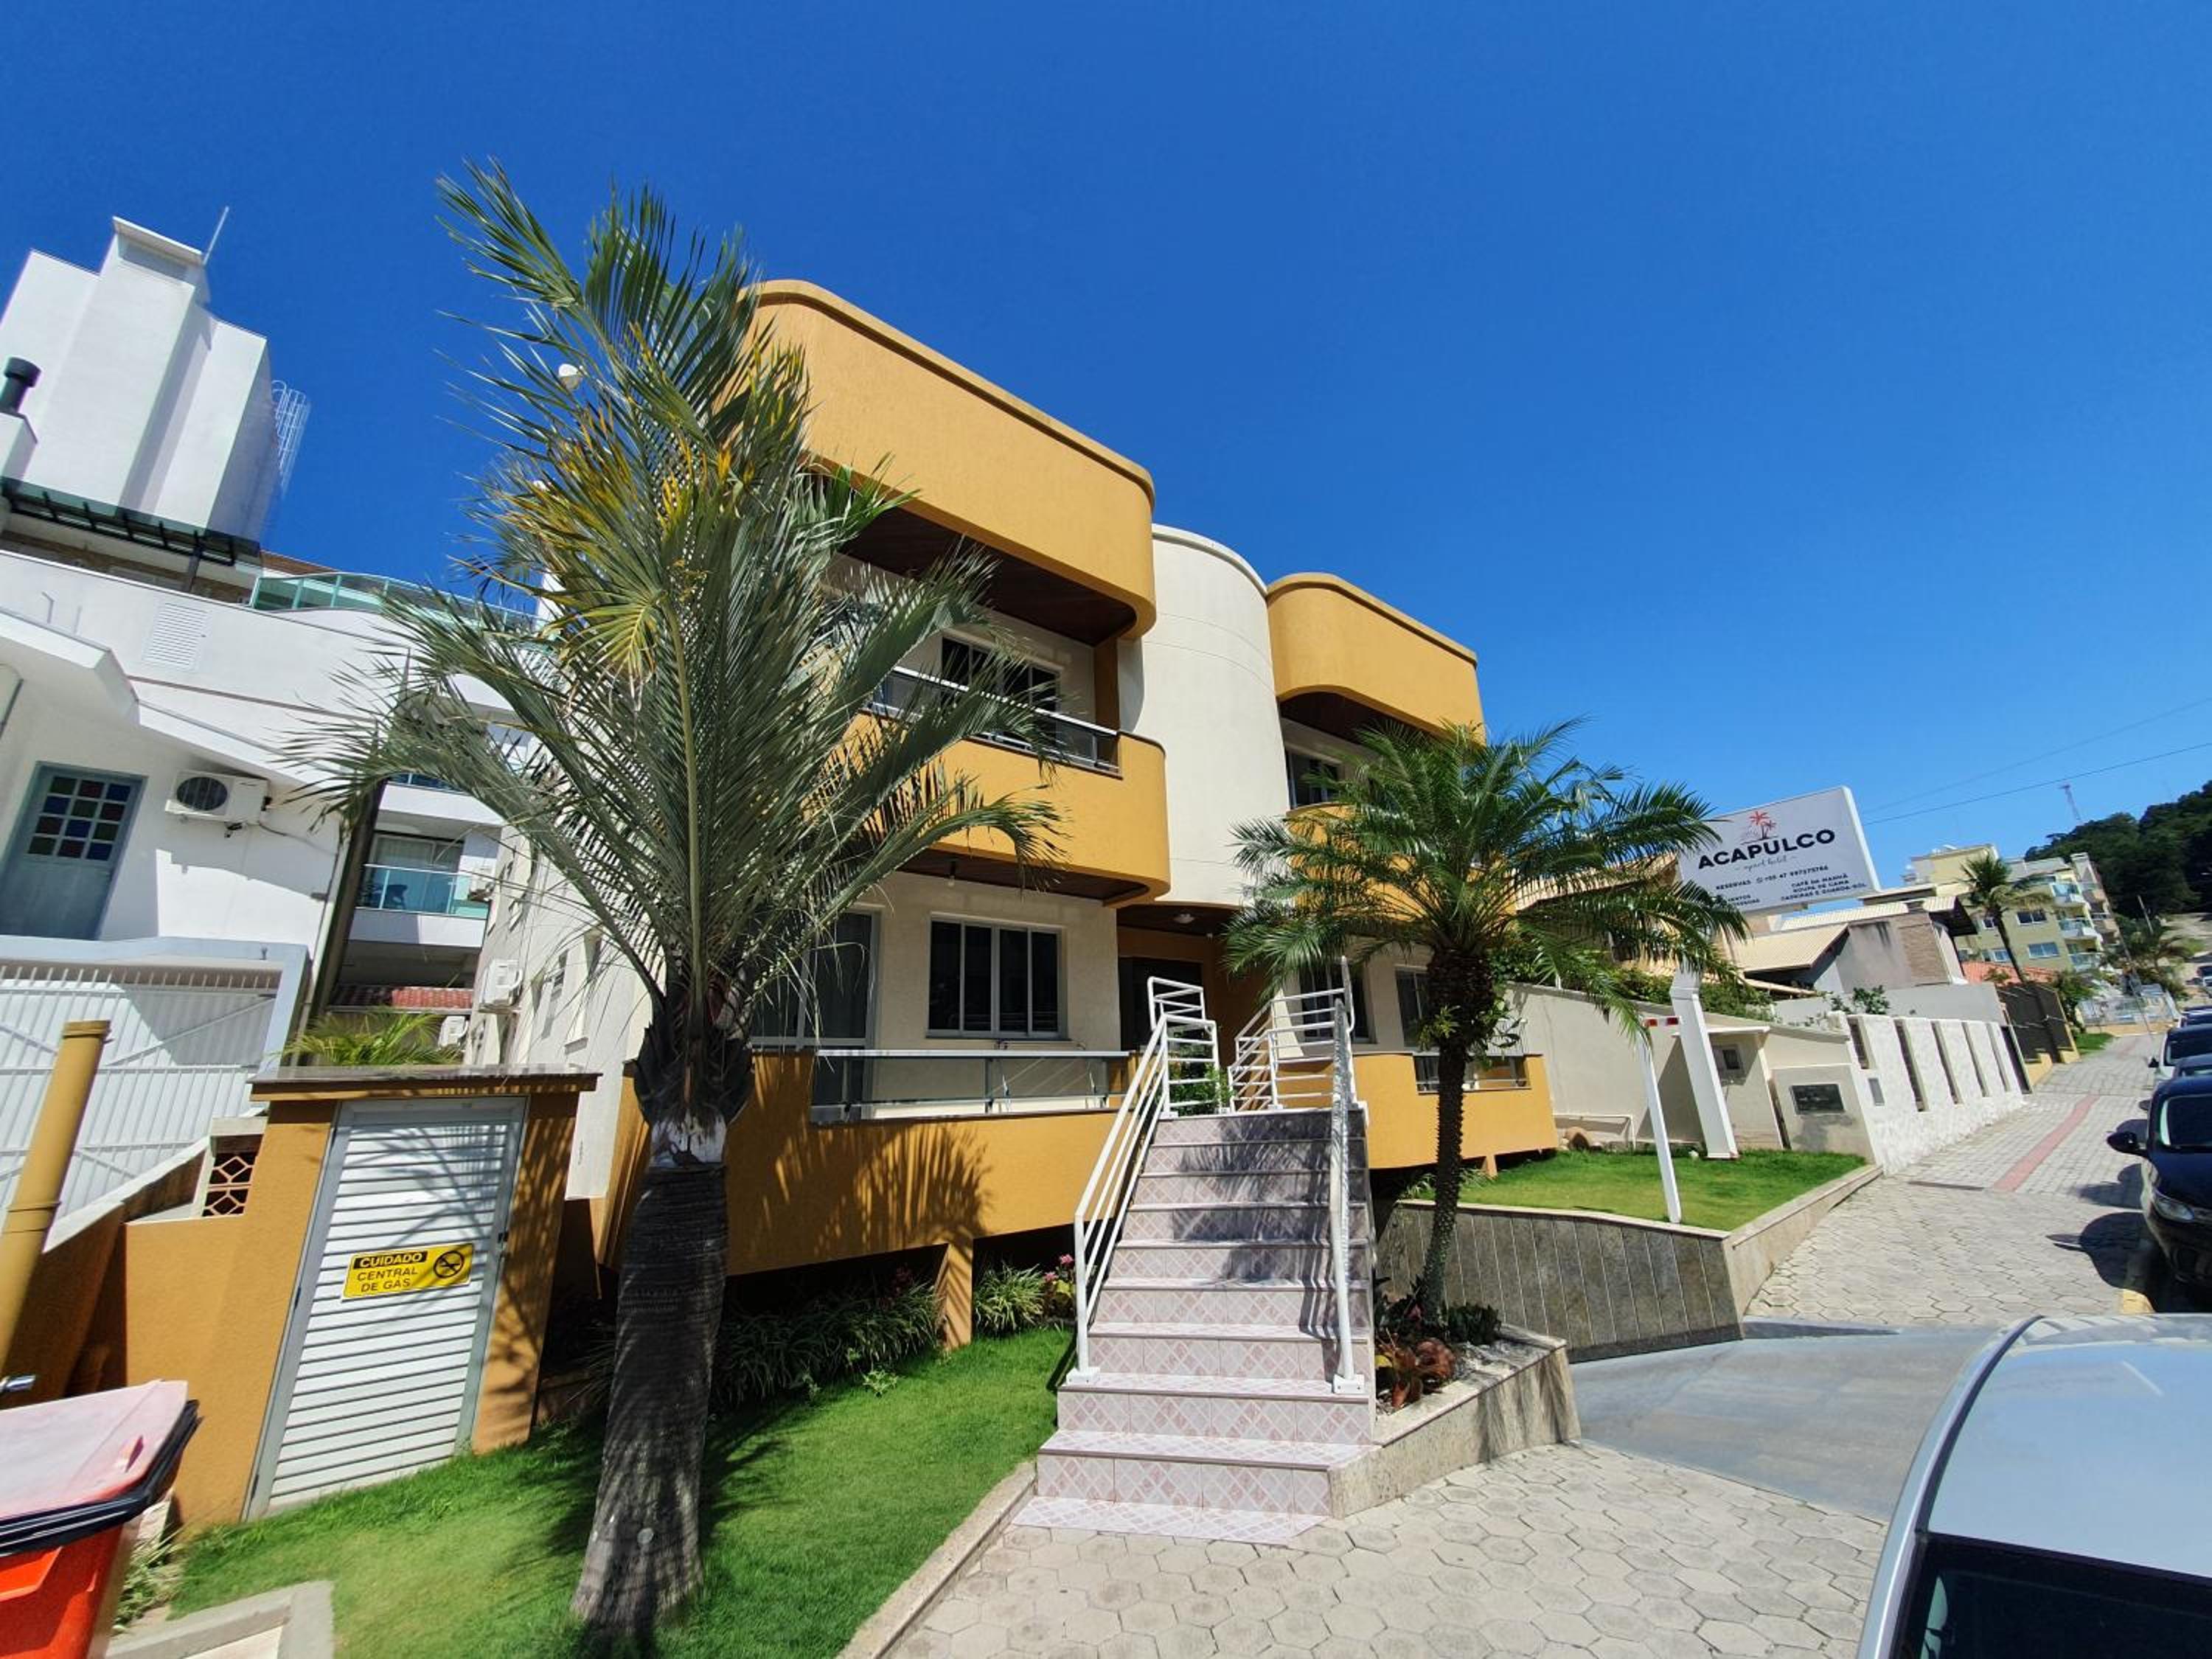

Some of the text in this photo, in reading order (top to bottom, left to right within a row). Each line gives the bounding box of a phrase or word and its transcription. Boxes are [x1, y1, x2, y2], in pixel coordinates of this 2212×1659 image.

[1698, 829, 1835, 869] ACAPULCO
[1716, 880, 1751, 890] RESERVAS
[359, 1253, 422, 1267] CUIDADO
[357, 1267, 418, 1281] CENTRAL
[361, 1282, 378, 1292] DE
